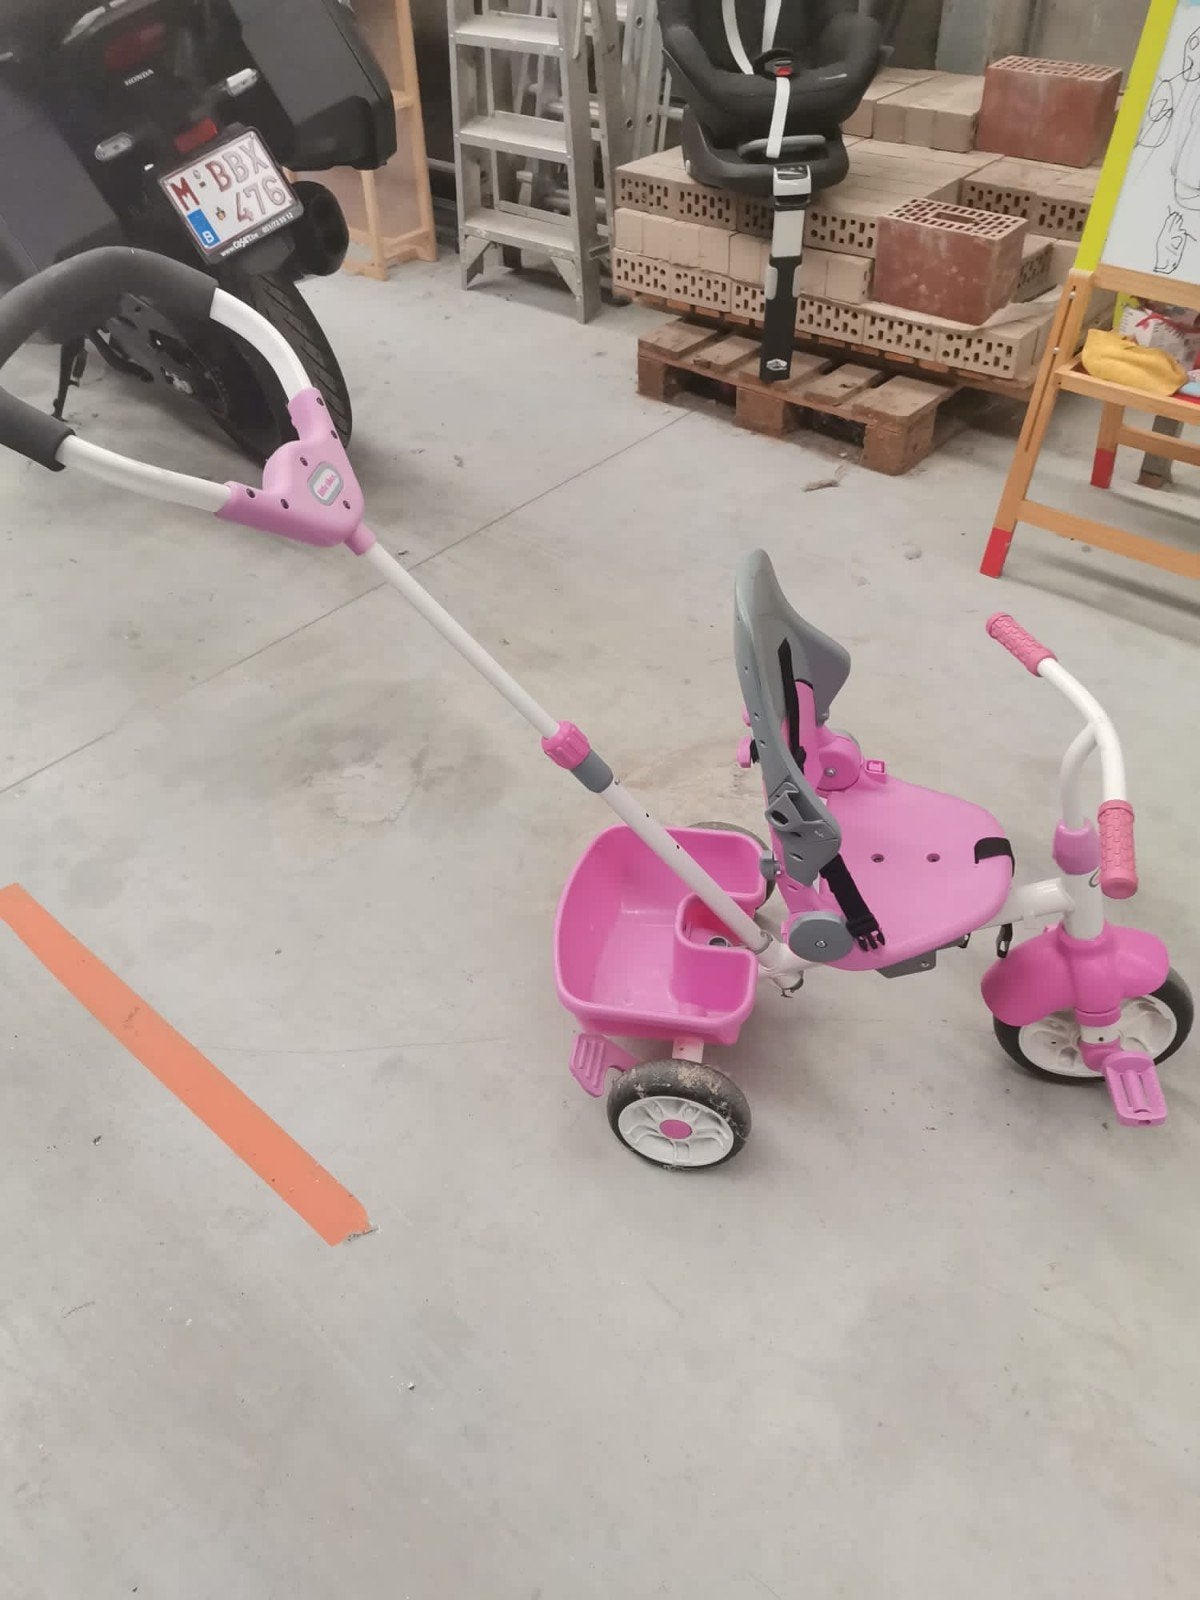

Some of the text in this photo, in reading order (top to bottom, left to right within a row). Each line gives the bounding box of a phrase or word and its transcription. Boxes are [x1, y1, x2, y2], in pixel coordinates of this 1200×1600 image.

[123, 69, 154, 86] HONDA
[236, 176, 286, 222] 476
[202, 231, 215, 244] B
